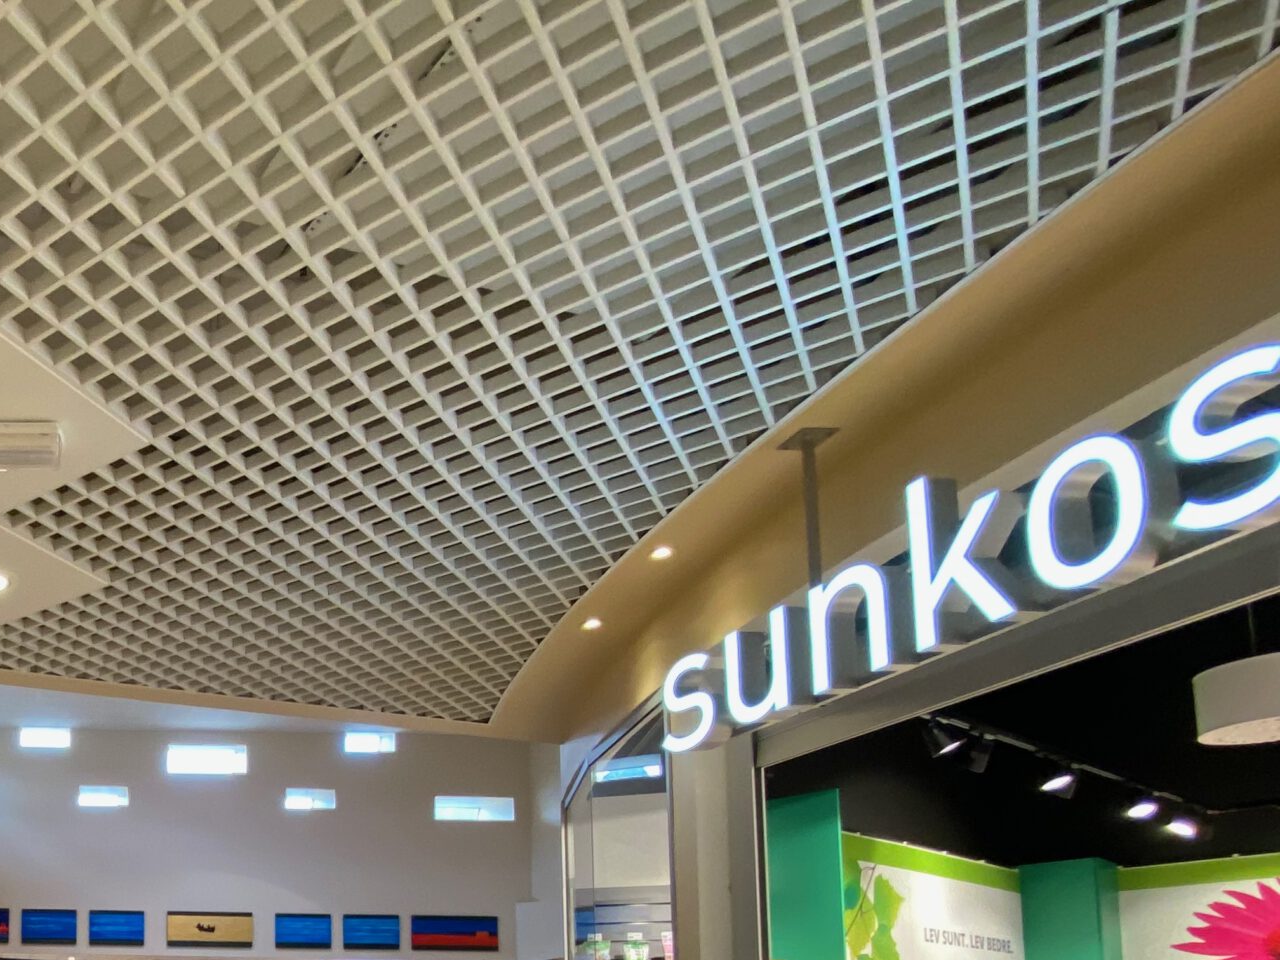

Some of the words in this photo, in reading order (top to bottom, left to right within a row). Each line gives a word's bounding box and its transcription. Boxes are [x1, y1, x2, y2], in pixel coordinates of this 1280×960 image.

[662, 343, 1280, 753] sunkos
[923, 927, 940, 944] LEV
[942, 930, 969, 949] SUNT.
[969, 934, 985, 950] LEV
[986, 936, 1014, 954] BEDRE.
